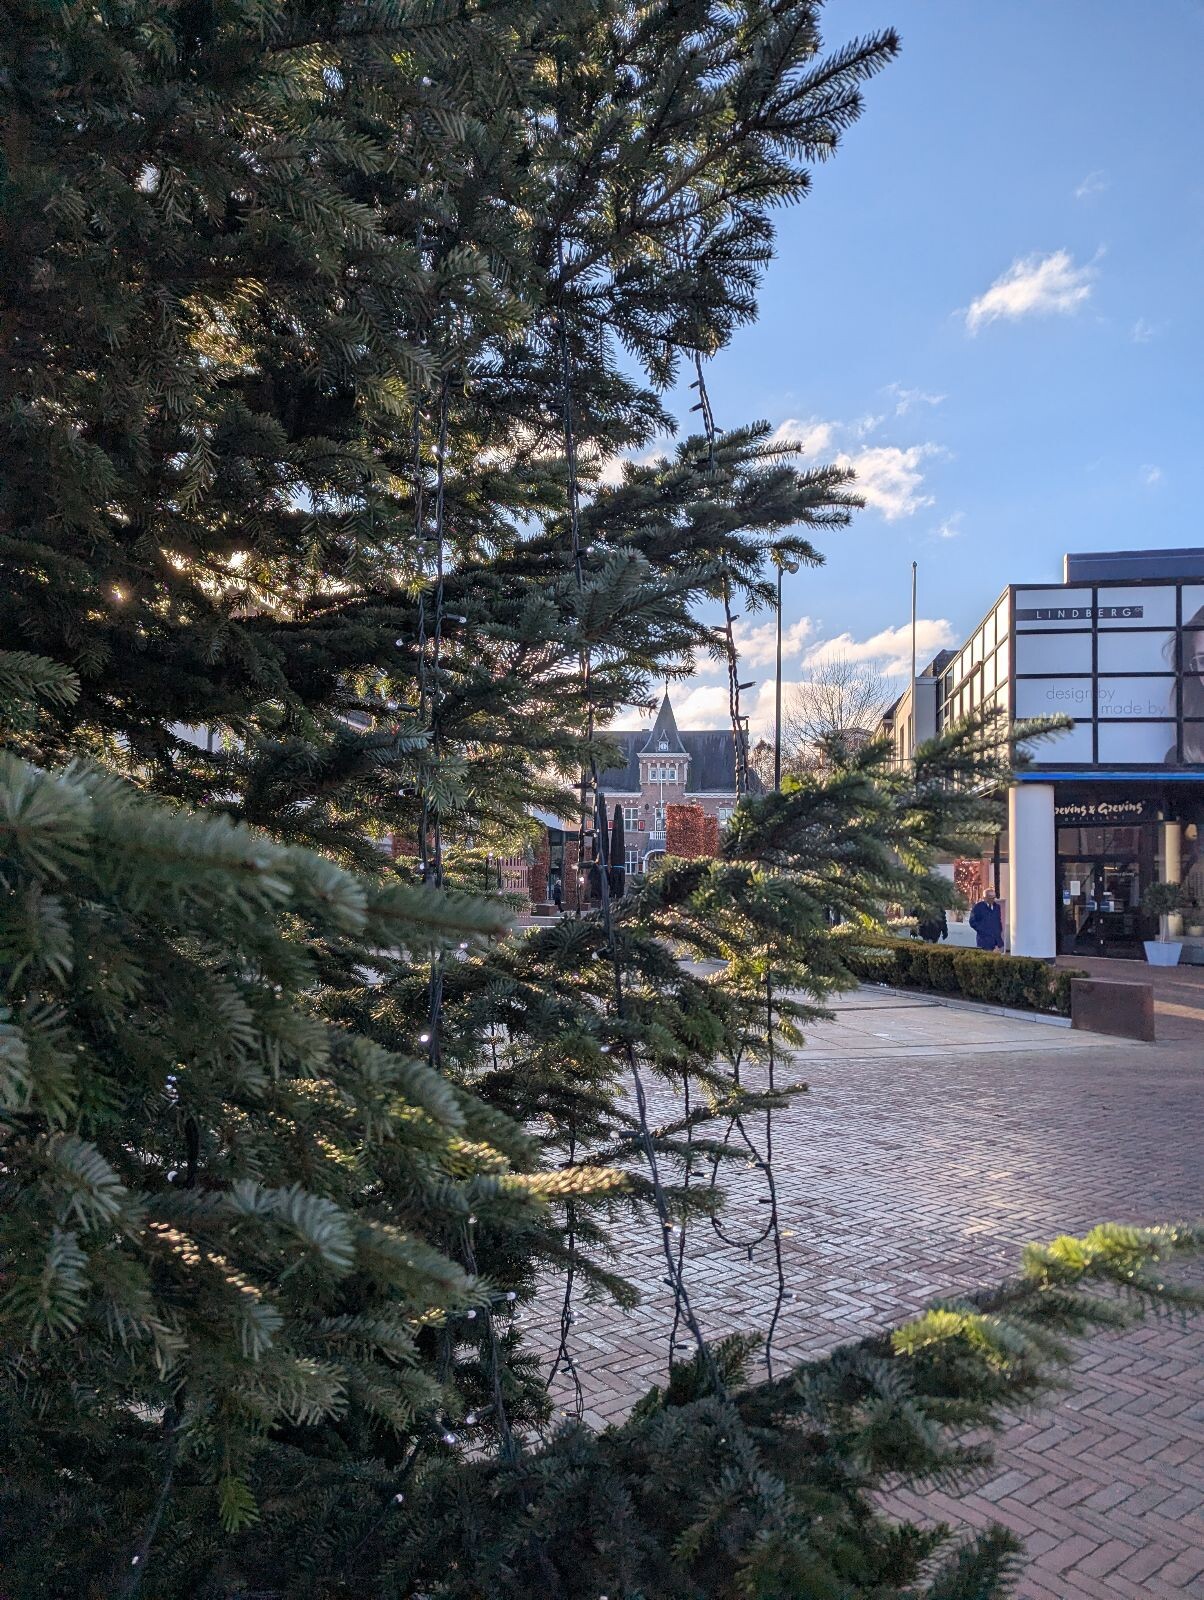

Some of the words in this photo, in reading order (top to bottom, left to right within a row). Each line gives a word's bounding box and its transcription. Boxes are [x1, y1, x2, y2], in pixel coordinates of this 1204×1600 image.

[1036, 608, 1132, 619] LINDBERG
[1098, 684, 1116, 702] by
[1101, 699, 1143, 715] made
[1148, 699, 1167, 717] by
[1055, 803, 1087, 816] reving
